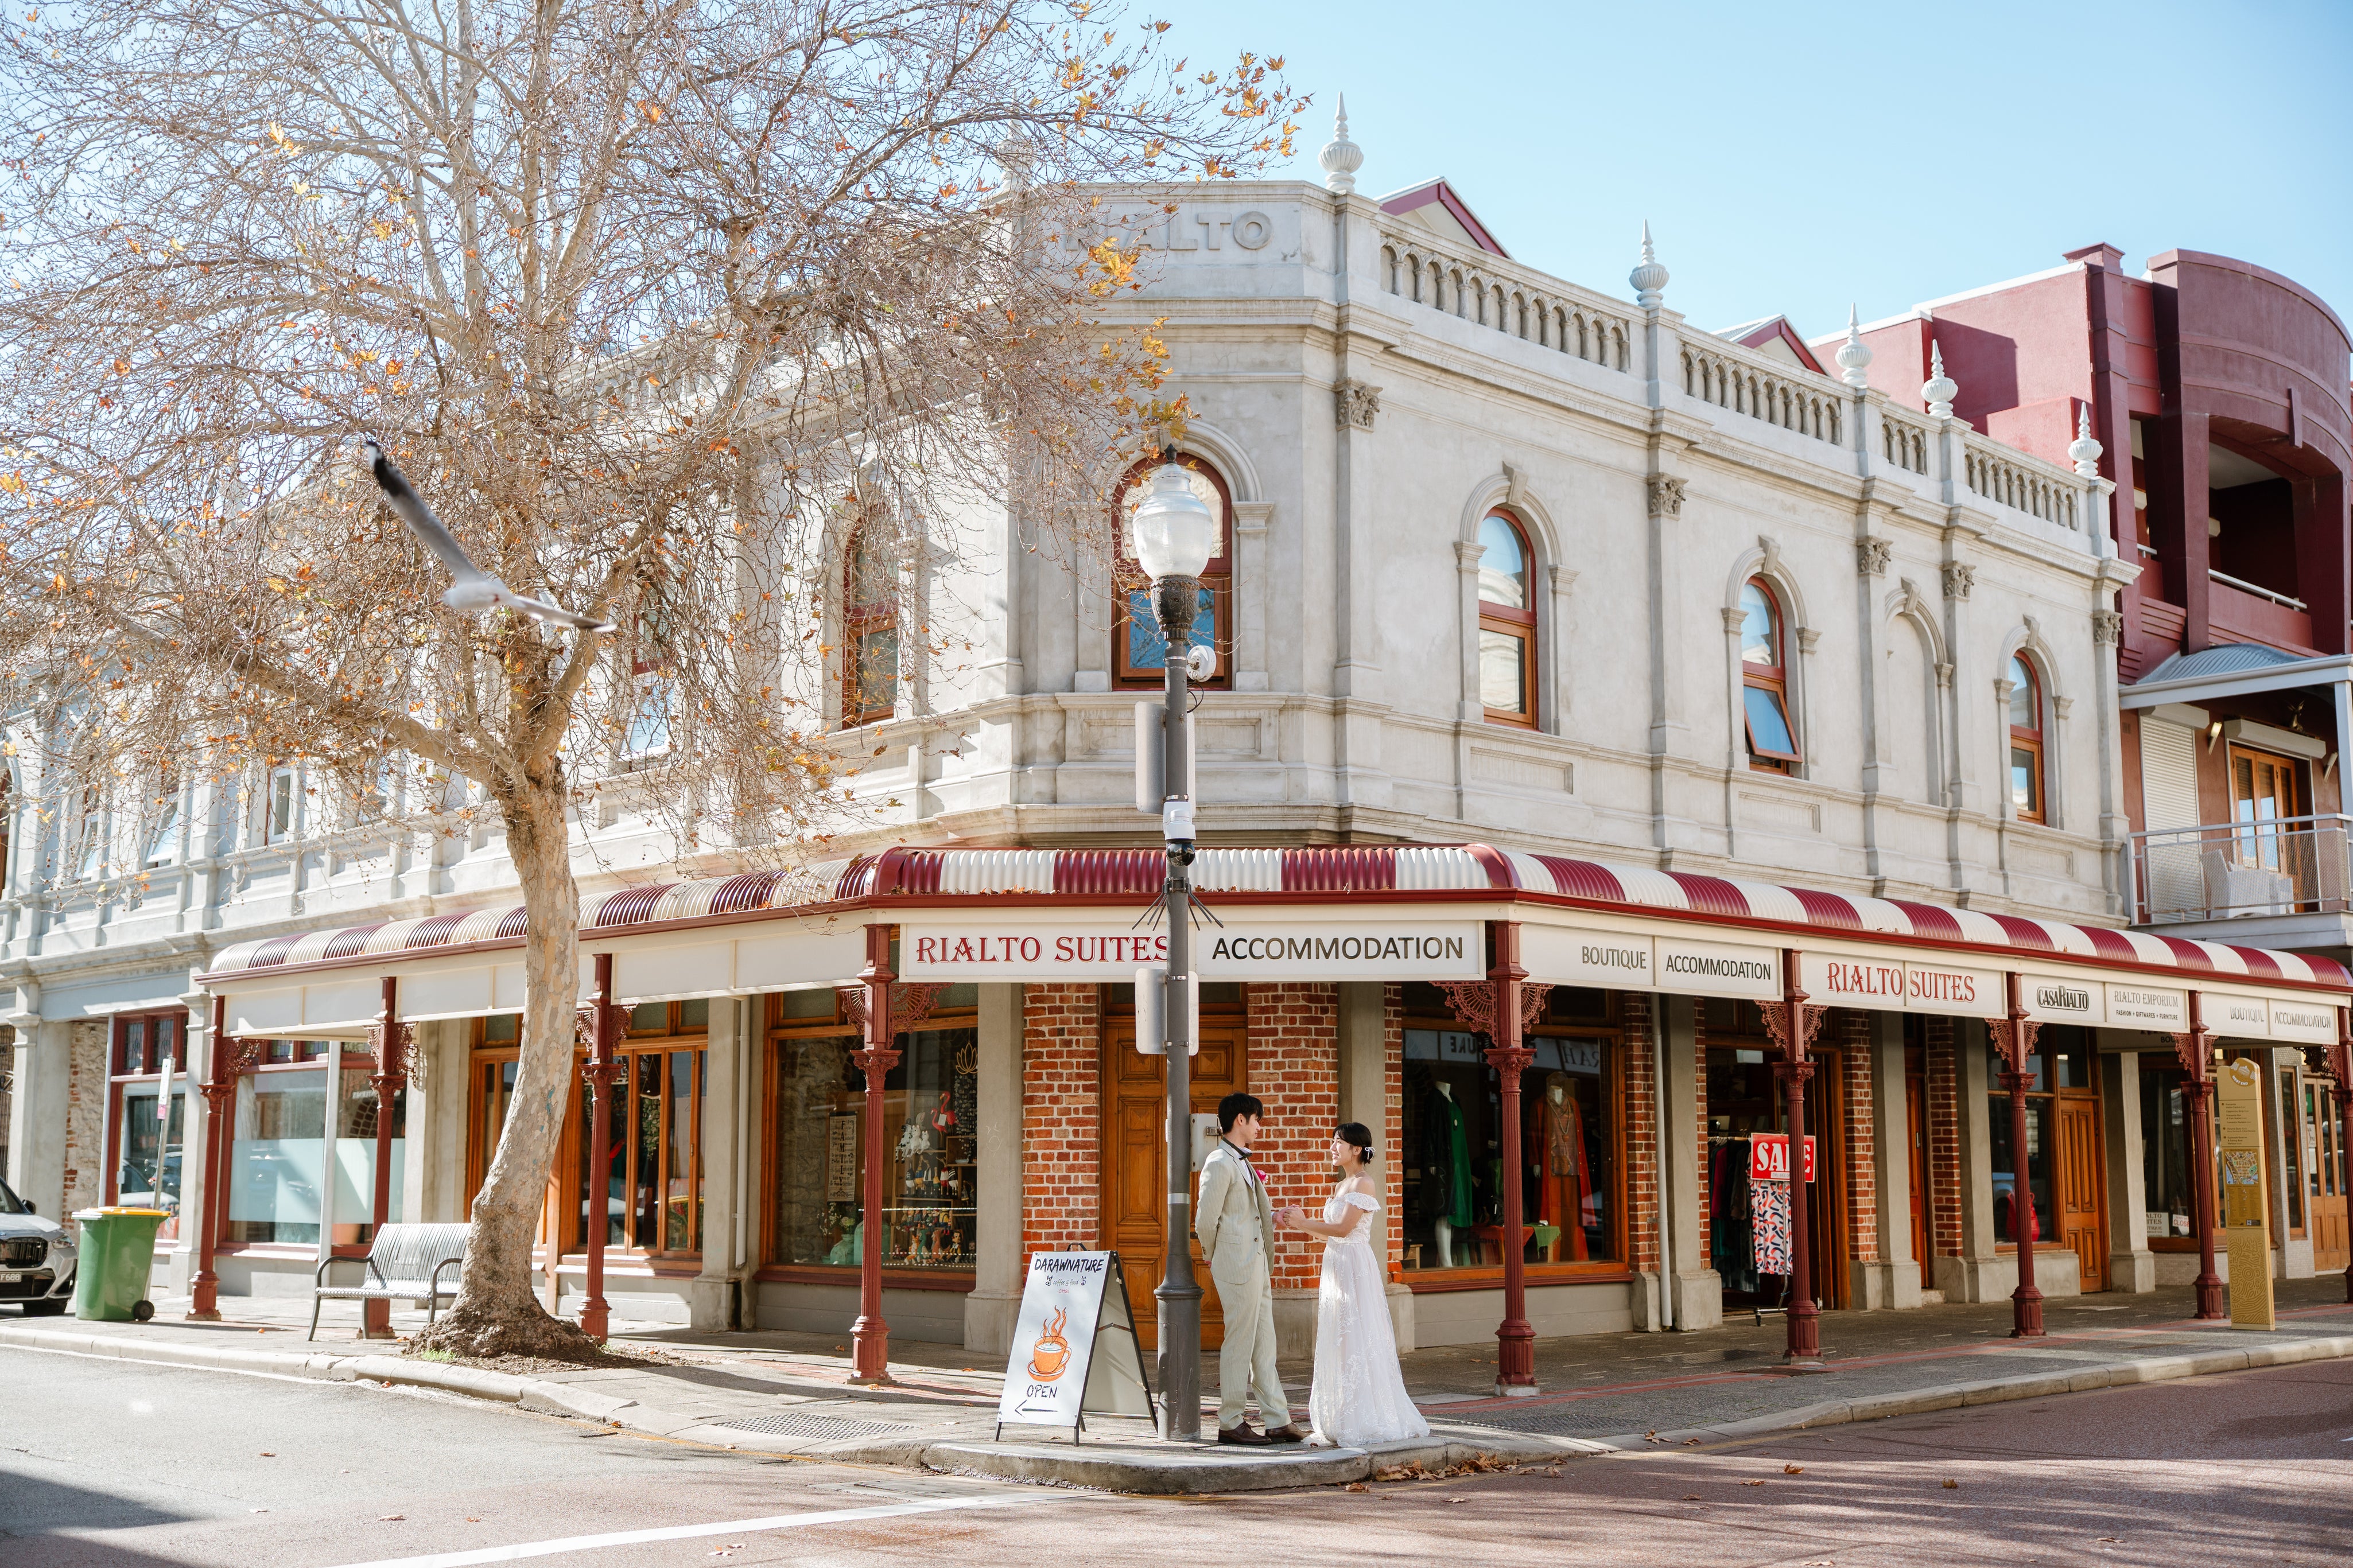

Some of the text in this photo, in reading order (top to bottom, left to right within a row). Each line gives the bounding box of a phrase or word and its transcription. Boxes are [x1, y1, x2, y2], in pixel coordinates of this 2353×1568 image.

[917, 936, 1167, 964] RIALTO SUITES
[1212, 936, 1463, 960] ACCOMMODATION
[1582, 946, 1770, 980] BOUTIQUE ACCOMMODATION
[1827, 962, 1975, 1003] RIALTO SUITES
[2114, 990, 2179, 1007] RIALTO EMPORIUM
[2230, 1006, 2331, 1028] BOUTIQUE ACCOMMODATION
[1035, 1258, 1104, 1273] DARAWNATURE
[1027, 1384, 1058, 1398] OPEN
